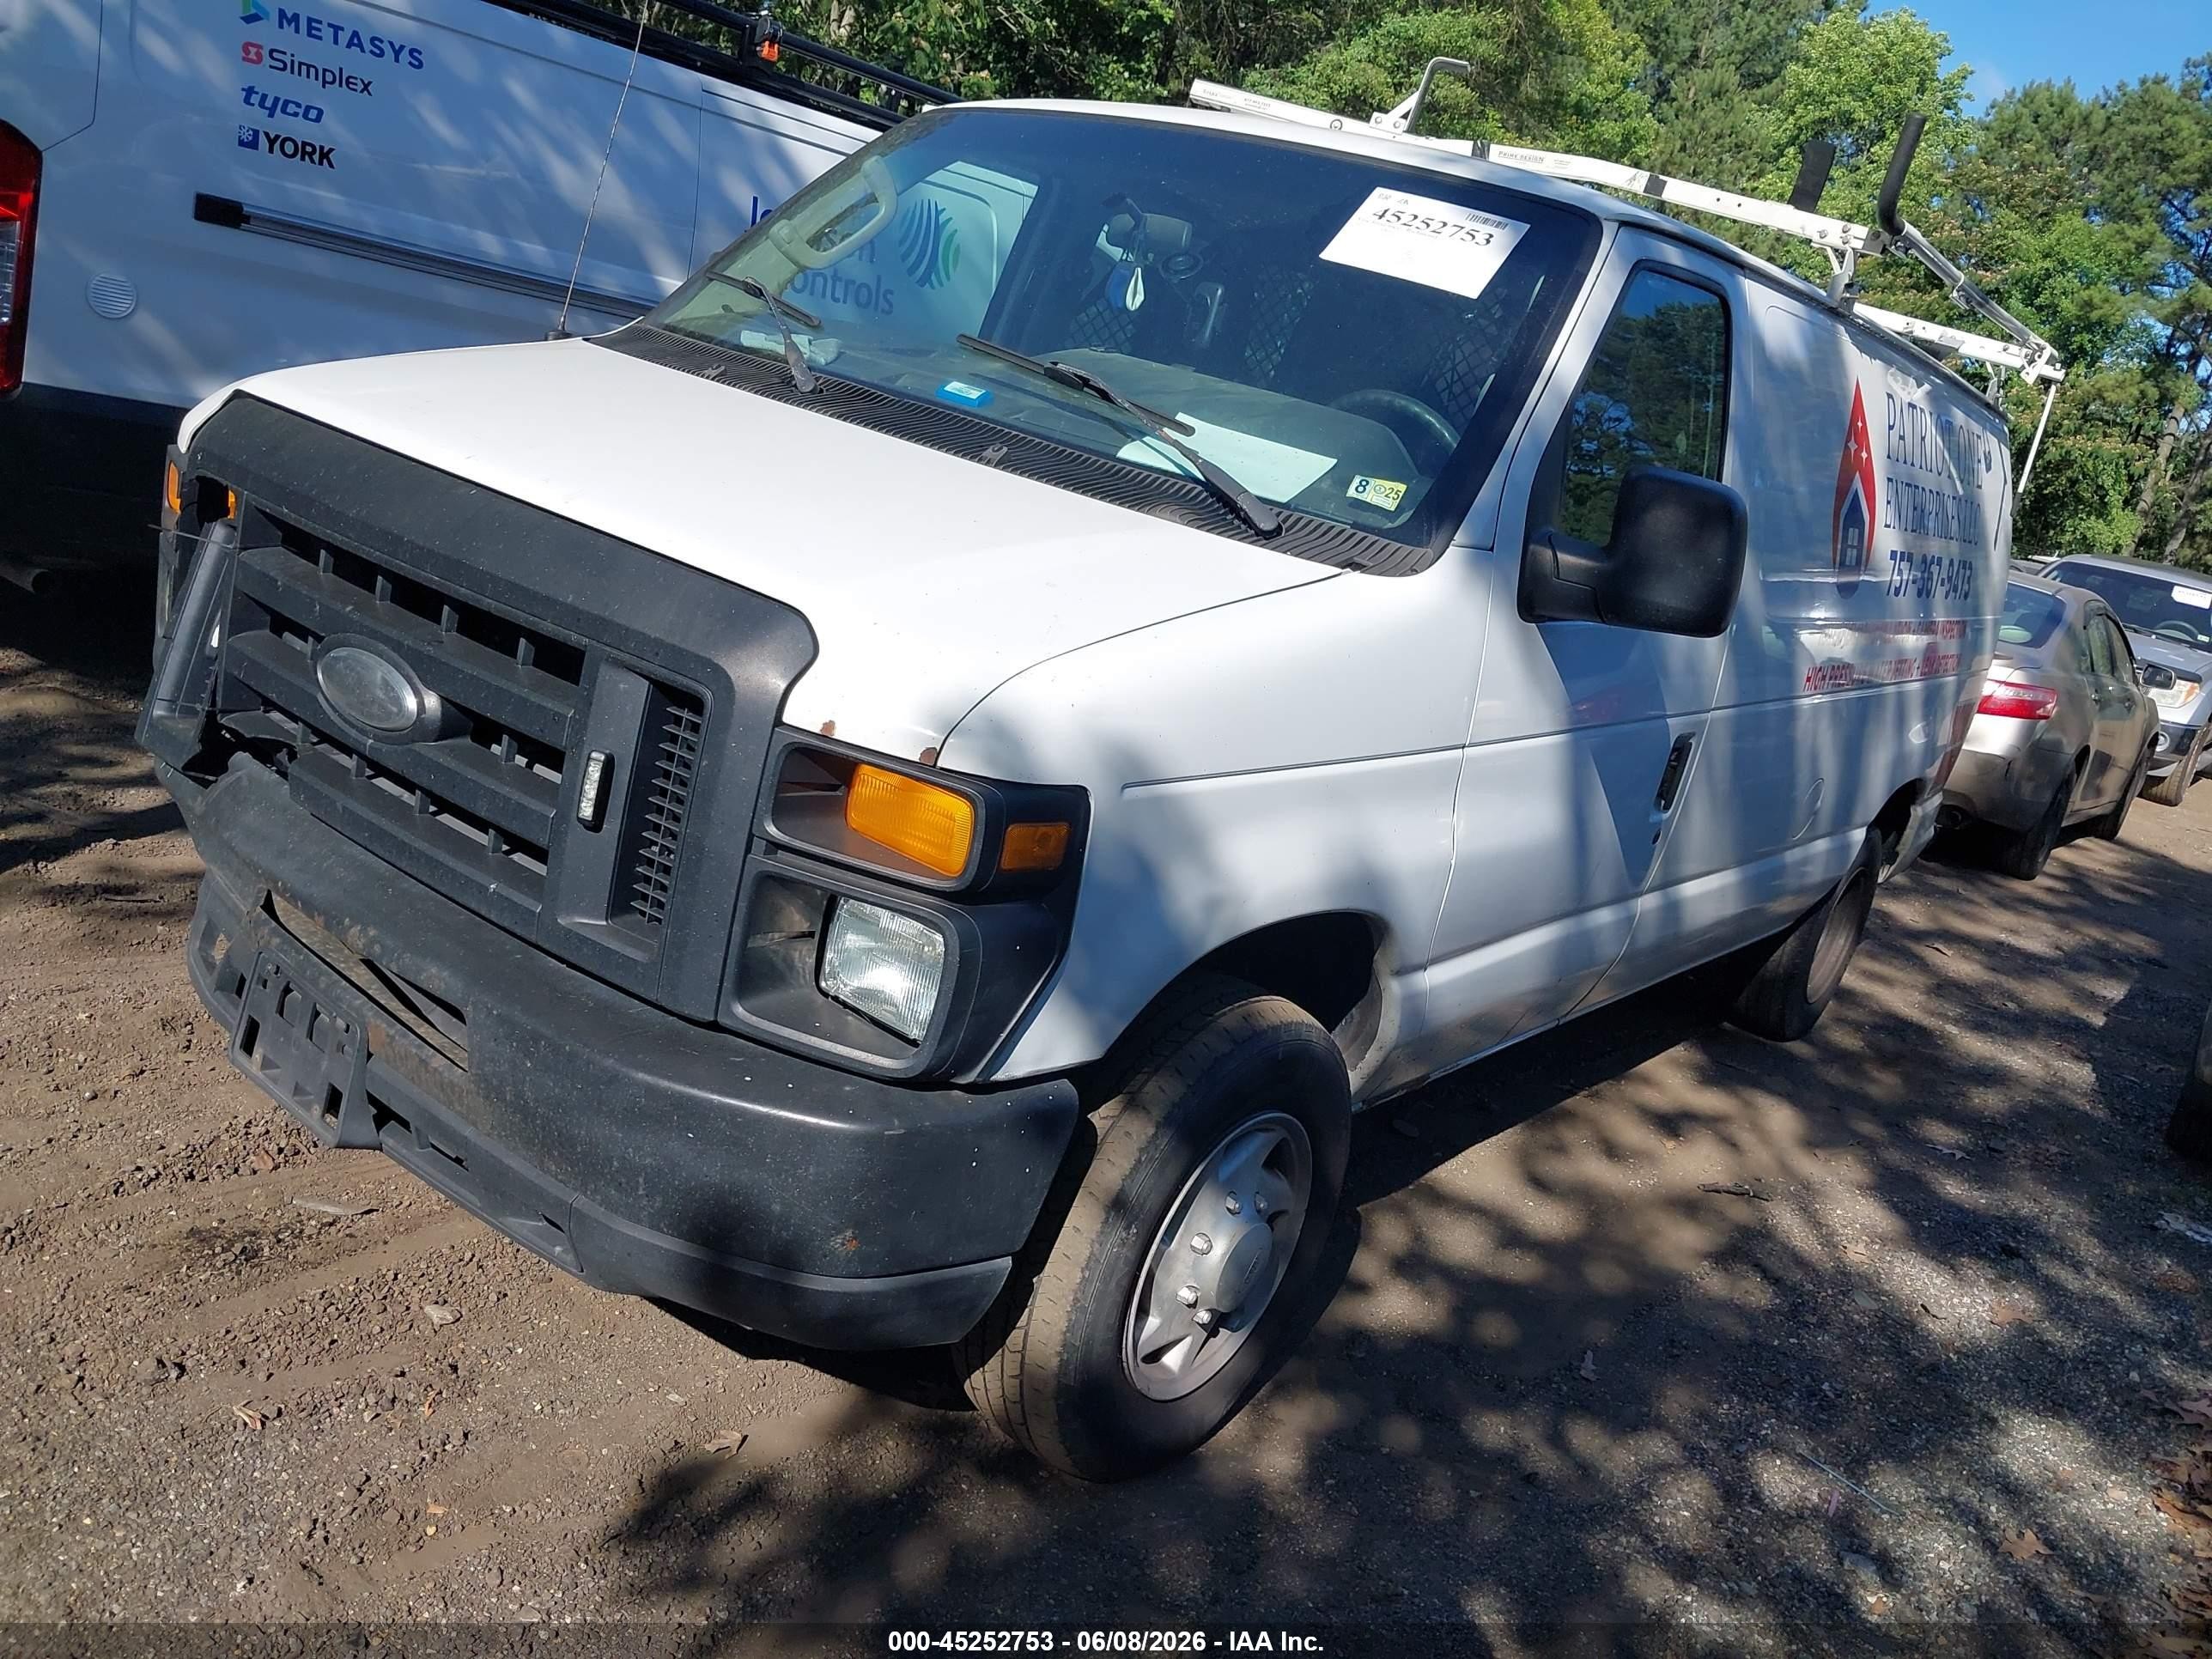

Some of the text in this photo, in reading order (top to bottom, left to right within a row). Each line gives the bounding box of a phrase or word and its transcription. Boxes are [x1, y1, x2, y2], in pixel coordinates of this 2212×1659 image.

[276, 7, 425, 70] METASYS
[268, 47, 374, 97] Simplex
[240, 85, 325, 125] tyco
[262, 131, 336, 170] YORK
[1372, 207, 1495, 246] 45252753
[787, 267, 895, 316] ontrols
[1885, 391, 1983, 490] PATRIOT ONE
[1354, 478, 1402, 501] 8 25
[1886, 549, 1973, 601] 757-367-9473
[1802, 665, 1828, 692] HIGH
